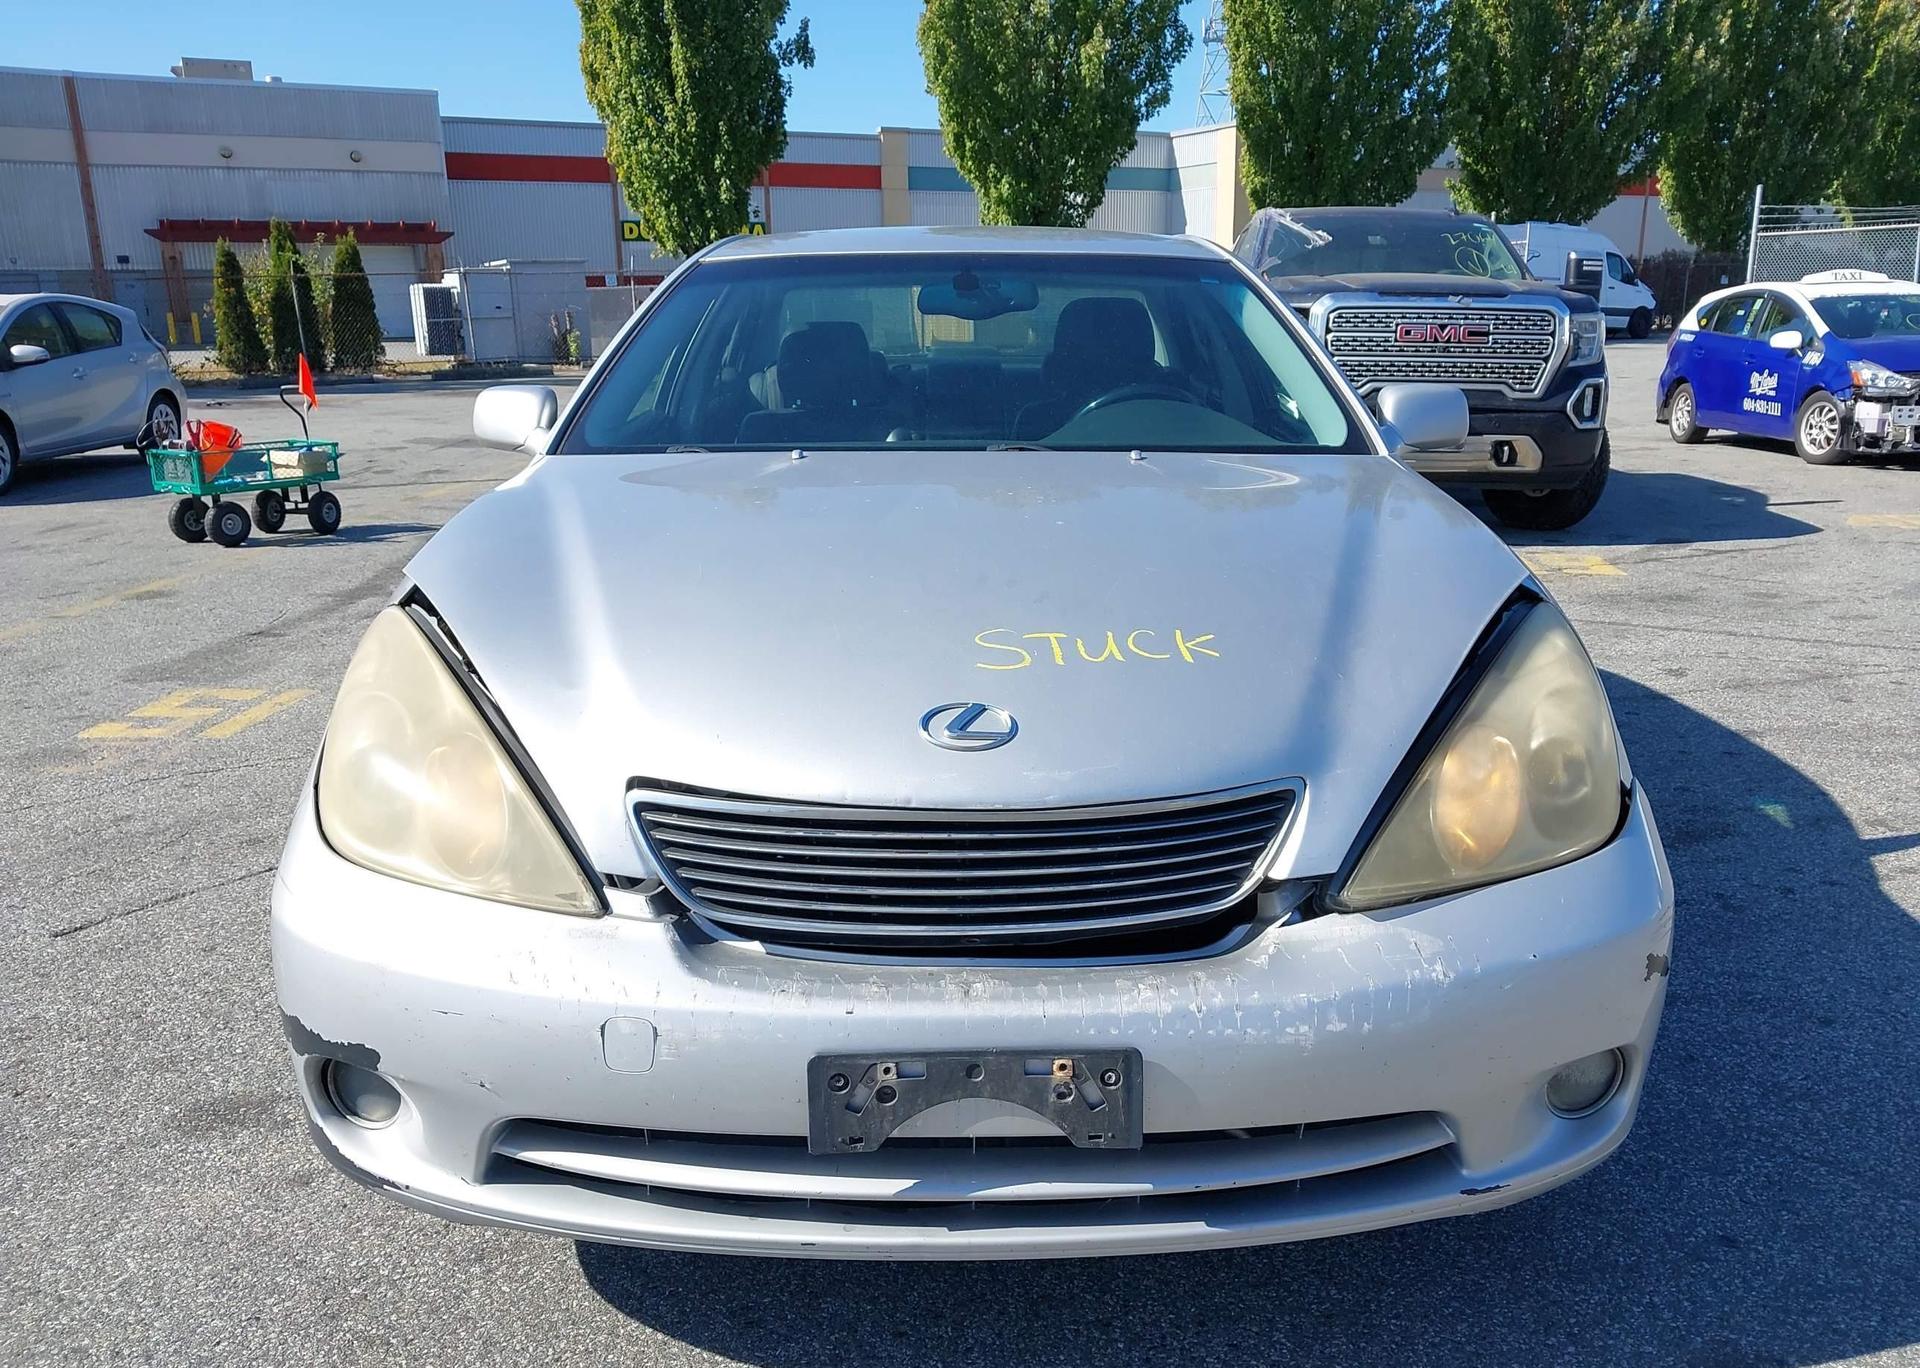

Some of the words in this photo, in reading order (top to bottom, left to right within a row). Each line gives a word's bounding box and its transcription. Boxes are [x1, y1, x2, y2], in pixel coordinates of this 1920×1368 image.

[1831, 271, 1863, 281] TAXI
[1396, 323, 1489, 343] GMC
[974, 628, 1220, 670] STUCK
